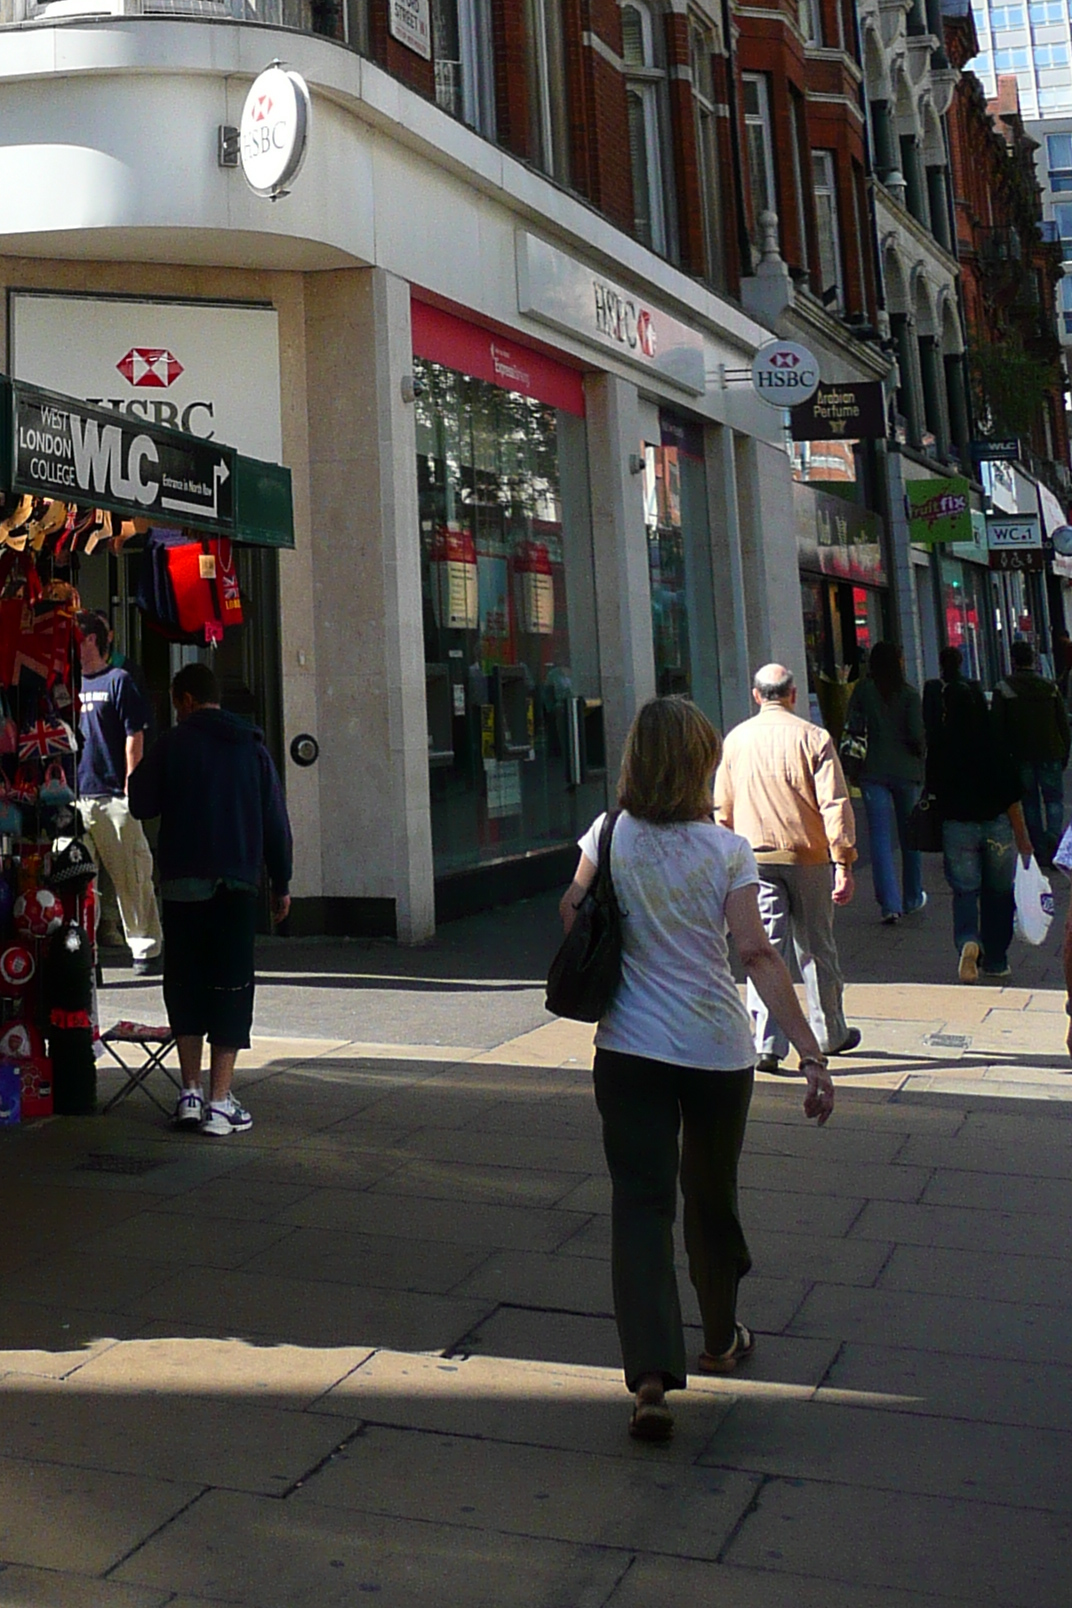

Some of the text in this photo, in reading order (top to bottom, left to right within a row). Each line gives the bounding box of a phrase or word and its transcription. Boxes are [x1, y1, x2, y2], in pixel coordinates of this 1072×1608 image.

[243, 120, 287, 162] HSBC
[758, 370, 815, 388] HSBC
[817, 389, 856, 405] Arabian
[40, 405, 70, 432] WEST
[86, 398, 216, 440] SBC
[813, 404, 860, 418] Perfume
[19, 427, 72, 459] LONDON
[30, 458, 76, 487] COLLEGE
[69, 413, 160, 505] WLC
[162, 473, 183, 491] Entrance
[183, 478, 188, 492] in
[189, 480, 203, 494] North
[993, 528, 1033, 541] WC.1
